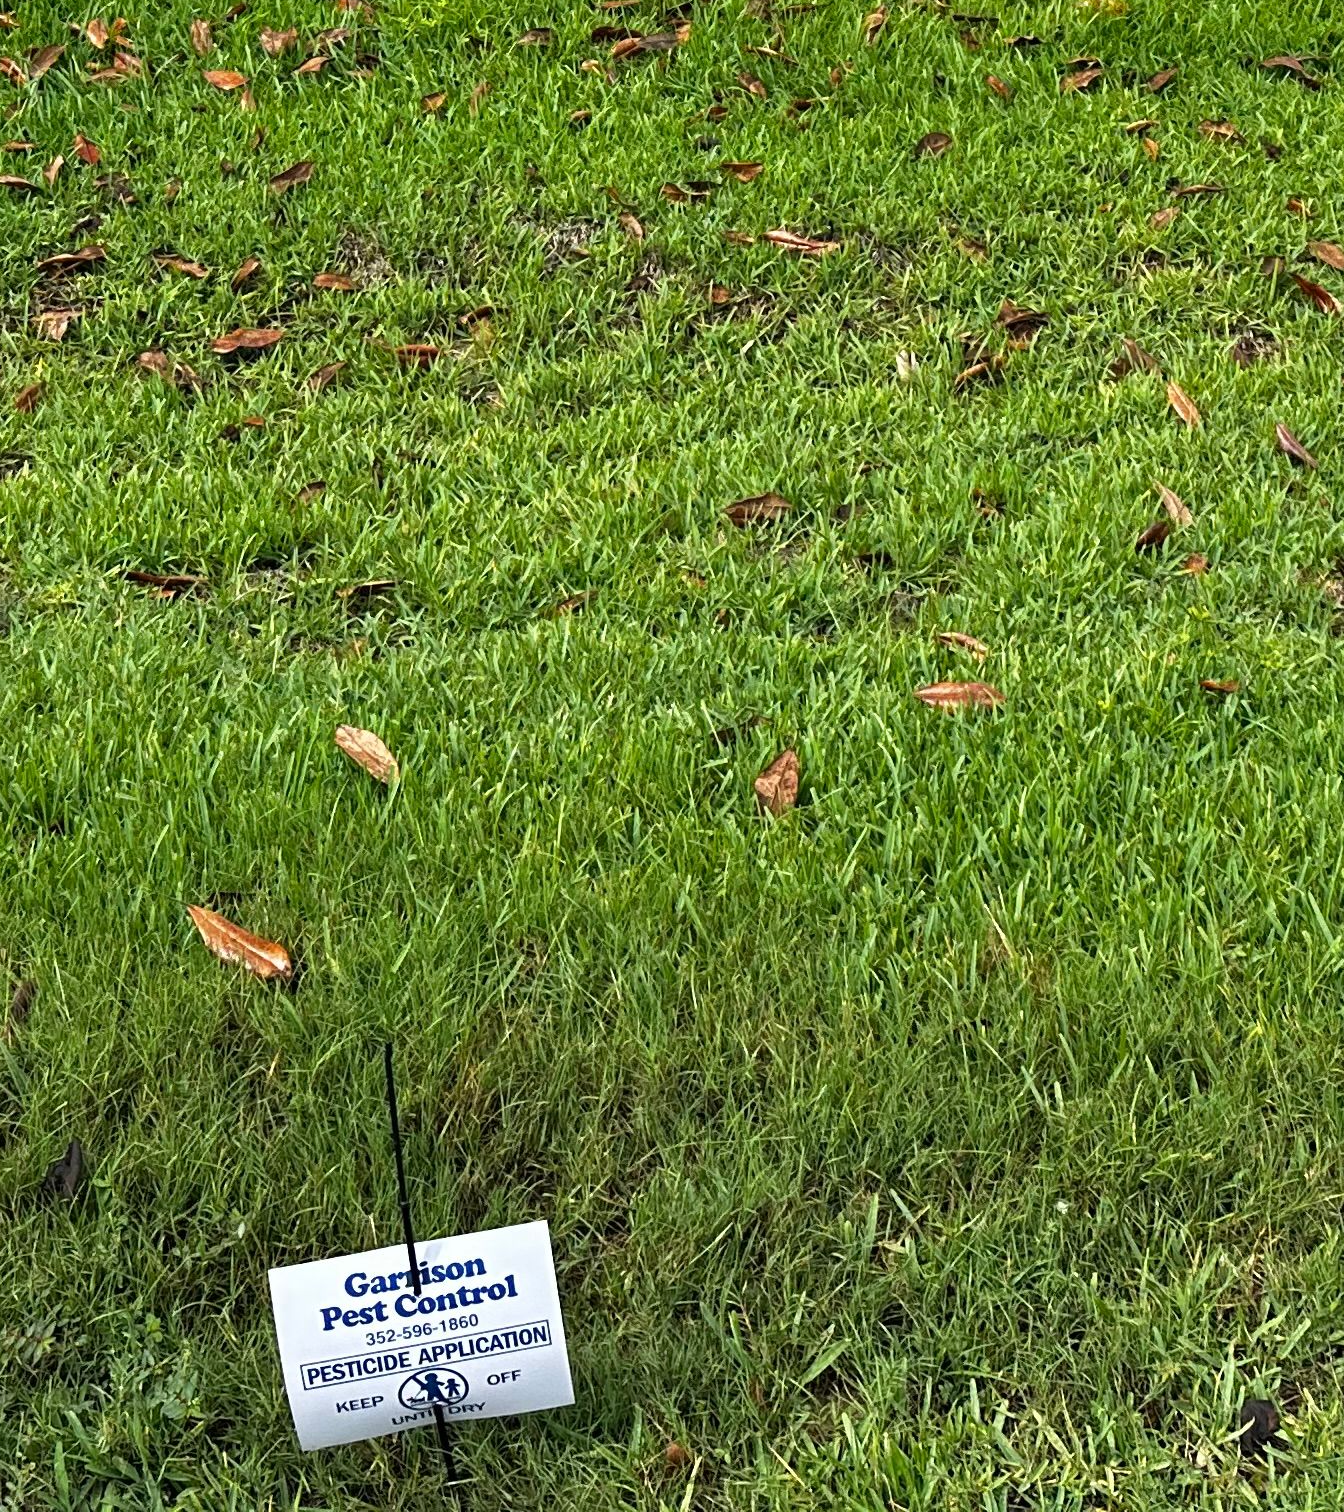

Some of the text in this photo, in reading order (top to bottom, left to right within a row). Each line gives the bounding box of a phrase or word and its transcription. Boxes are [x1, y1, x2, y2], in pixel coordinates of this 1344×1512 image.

[320, 1275, 518, 1331] Pest Control
[366, 1314, 479, 1346] 352-596-1860
[307, 1325, 548, 1385] PESTICIDE APPLICATION
[335, 1369, 522, 1413] KEEP OFF
[391, 1402, 486, 1425] UNTI DRY
